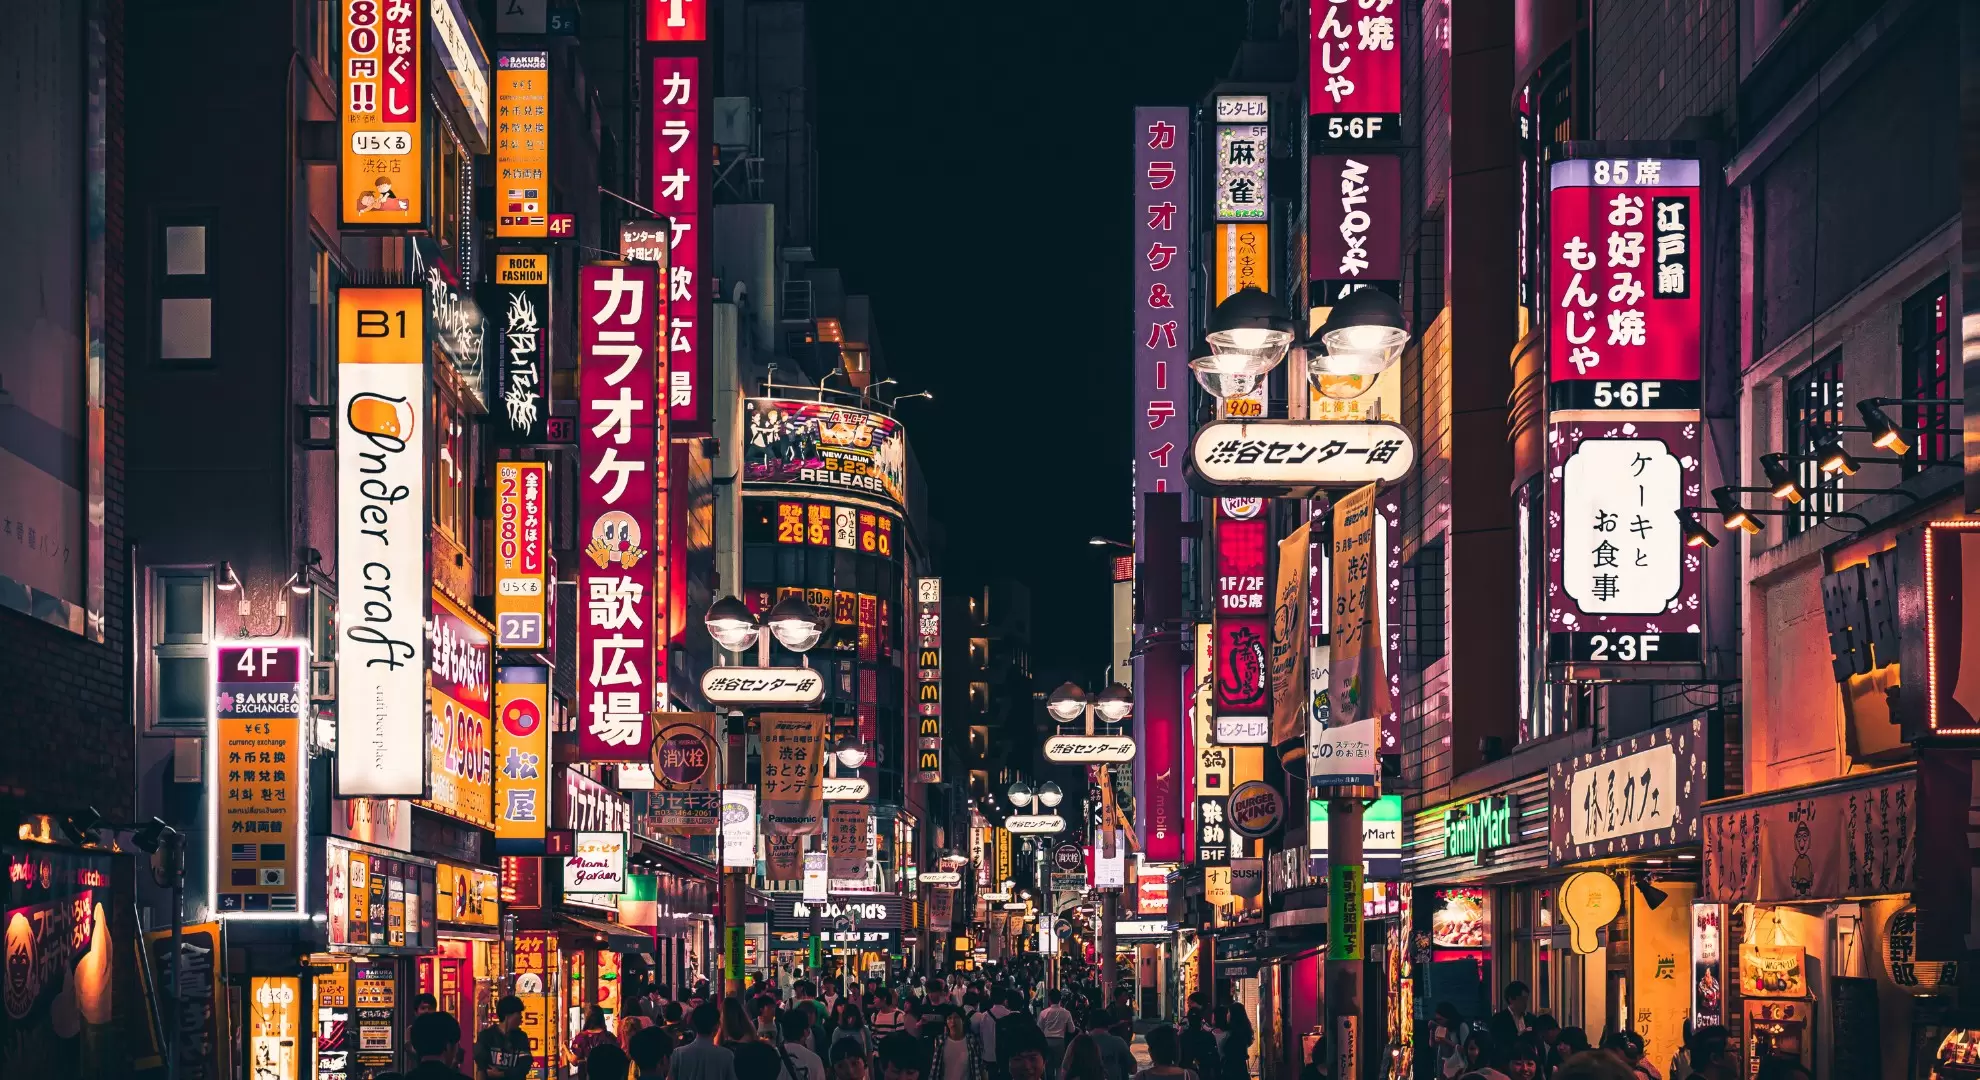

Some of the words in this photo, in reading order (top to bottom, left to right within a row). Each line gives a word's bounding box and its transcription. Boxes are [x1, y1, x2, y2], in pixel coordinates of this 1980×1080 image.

[1317, 0, 1355, 103] んじゃ
[1218, 102, 1266, 116] センタービル
[1252, 126, 1266, 136] 5F
[357, 136, 406, 149] りらくる
[1229, 140, 1255, 203] 麻雀
[1594, 158, 1661, 185] 85席
[550, 219, 571, 233] 4F
[624, 231, 665, 243] センター街
[662, 72, 692, 406] カラオケ歌広場
[1657, 202, 1685, 294] 江戸前
[509, 258, 536, 269] ROCK
[1607, 193, 1646, 346] お好み焼
[502, 270, 543, 281] FASHION
[1562, 236, 1600, 375] もんじゃ
[356, 310, 407, 339] B1
[589, 268, 646, 504] カラオケ
[551, 421, 570, 439] 3F
[822, 450, 841, 459] NEW
[843, 453, 869, 464] ALBUM
[1205, 440, 1404, 464] 渋谷センター街
[825, 458, 867, 474] 5.23
[800, 468, 883, 492] RELEASE
[1230, 497, 1256, 510] KING
[1630, 452, 1653, 567] ケーキと
[525, 471, 539, 570] 全身もみほぐし
[1591, 509, 1620, 601] お食事
[1347, 552, 1369, 584] 渋谷
[503, 582, 538, 592] りらくる
[1220, 576, 1264, 591] 1F/2F
[1221, 594, 1263, 609] 105席
[347, 562, 415, 672] craft
[505, 619, 536, 639] 2F
[236, 647, 278, 677] 4F
[432, 614, 490, 702] 全身もみほぐし
[587, 575, 645, 746] 歌広場
[708, 678, 817, 692] 渋谷センター街
[236, 692, 299, 704] SAKURA
[235, 704, 290, 714] EXCHANGE
[1218, 723, 1267, 737] センタービル
[256, 738, 286, 747] exchange
[1050, 743, 1133, 755] 渋谷センター街
[1336, 741, 1370, 749] ステッカー
[663, 748, 705, 768] 消火栓
[779, 746, 808, 760] 渋谷
[765, 763, 819, 777] おとなり
[502, 748, 539, 822] 松屋
[765, 779, 820, 793] サンデー
[229, 787, 253, 801] 외화
[261, 787, 286, 801] 환전
[1236, 793, 1274, 813] BURGER
[768, 814, 817, 823] Panasonic
[1237, 803, 1276, 823] KING
[231, 820, 283, 833] 外貨両替
[1008, 819, 1060, 830] 渋谷センター街
[1444, 795, 1511, 866] FamilyMart
[552, 835, 569, 852] 1F
[831, 835, 865, 844] おとなり
[831, 845, 865, 853] サンデー
[1201, 850, 1225, 860] B1F
[566, 856, 610, 868] Miami
[1058, 853, 1079, 863] 消火栓
[77, 868, 111, 887] Kitchen
[1207, 870, 1231, 885] すし
[1232, 869, 1262, 878] SUSHI
